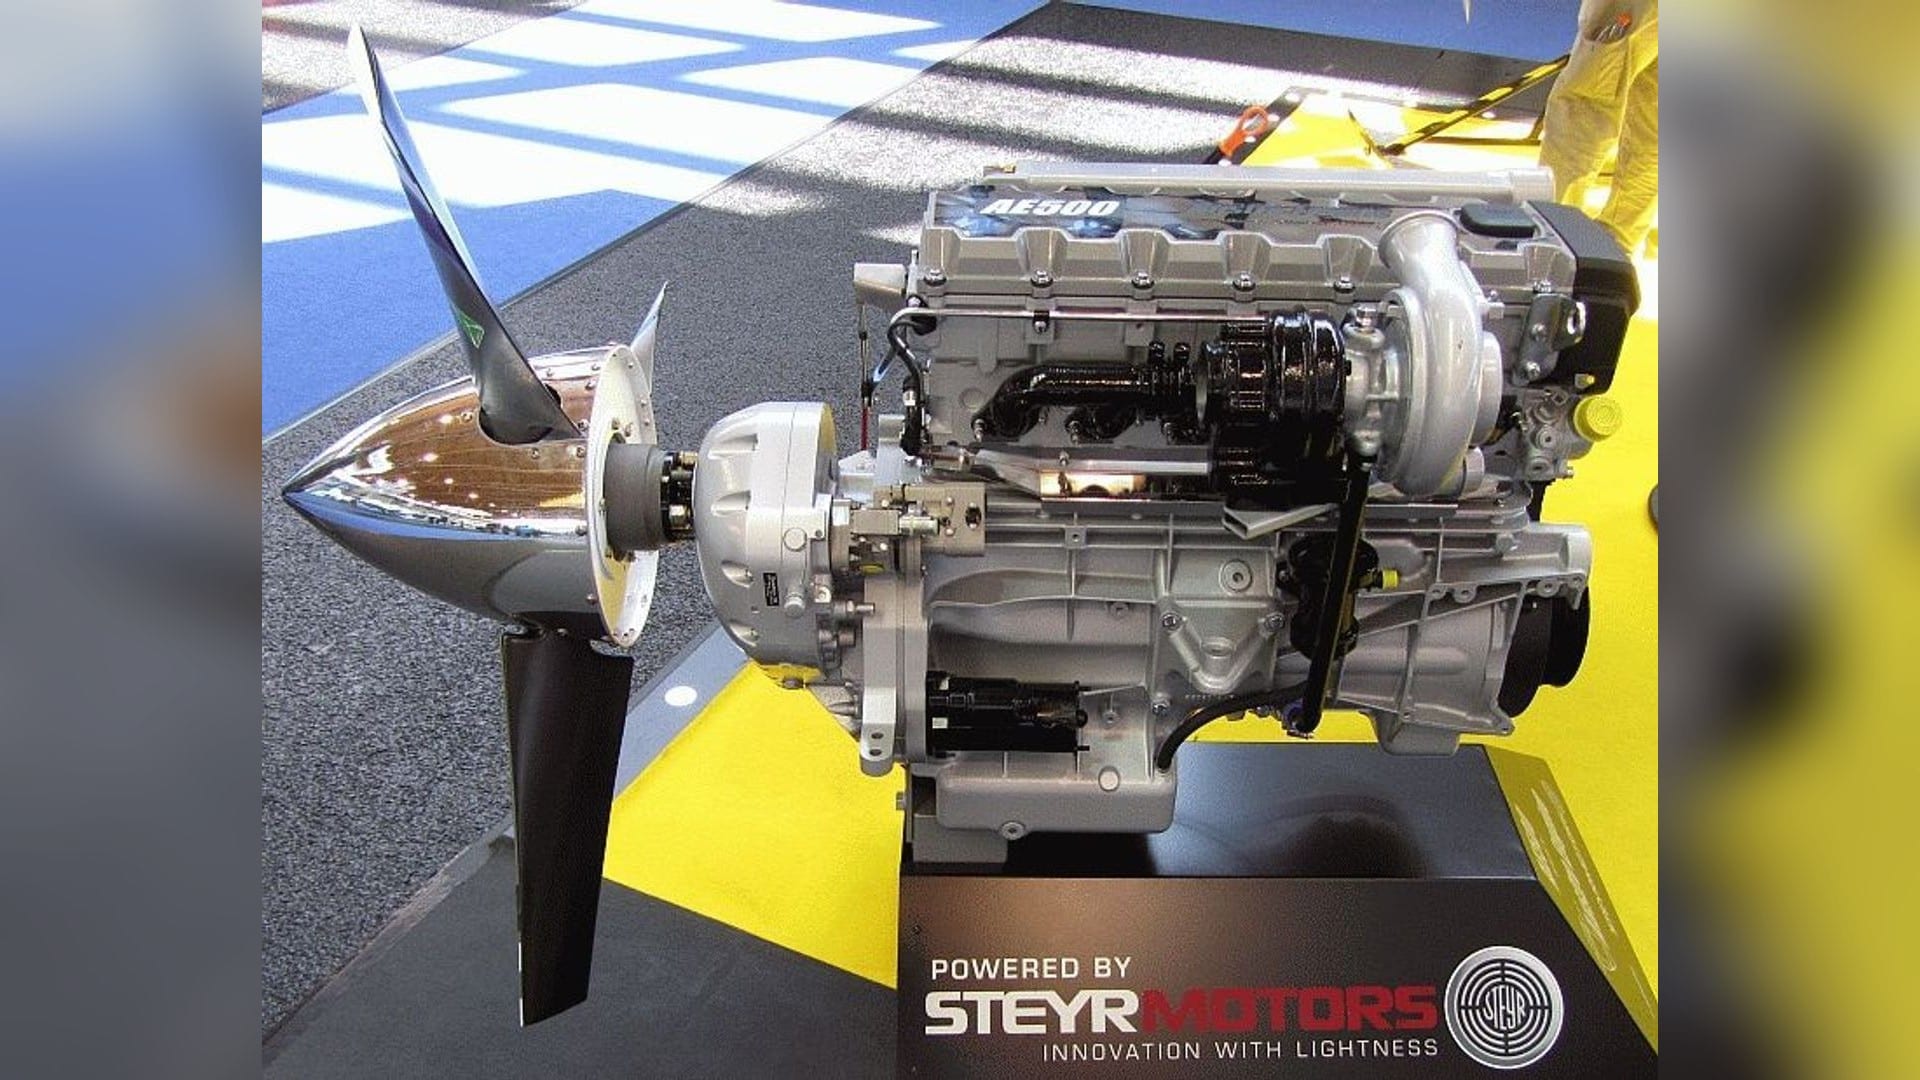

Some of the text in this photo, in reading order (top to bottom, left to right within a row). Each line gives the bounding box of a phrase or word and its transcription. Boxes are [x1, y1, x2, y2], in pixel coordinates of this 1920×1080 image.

[979, 199, 1120, 216] AE500
[931, 956, 1131, 980] POWERED BY
[1483, 984, 1527, 1030] STEYR
[1043, 1038, 1438, 1062] INNOVATION WITH LIGHTNESS
